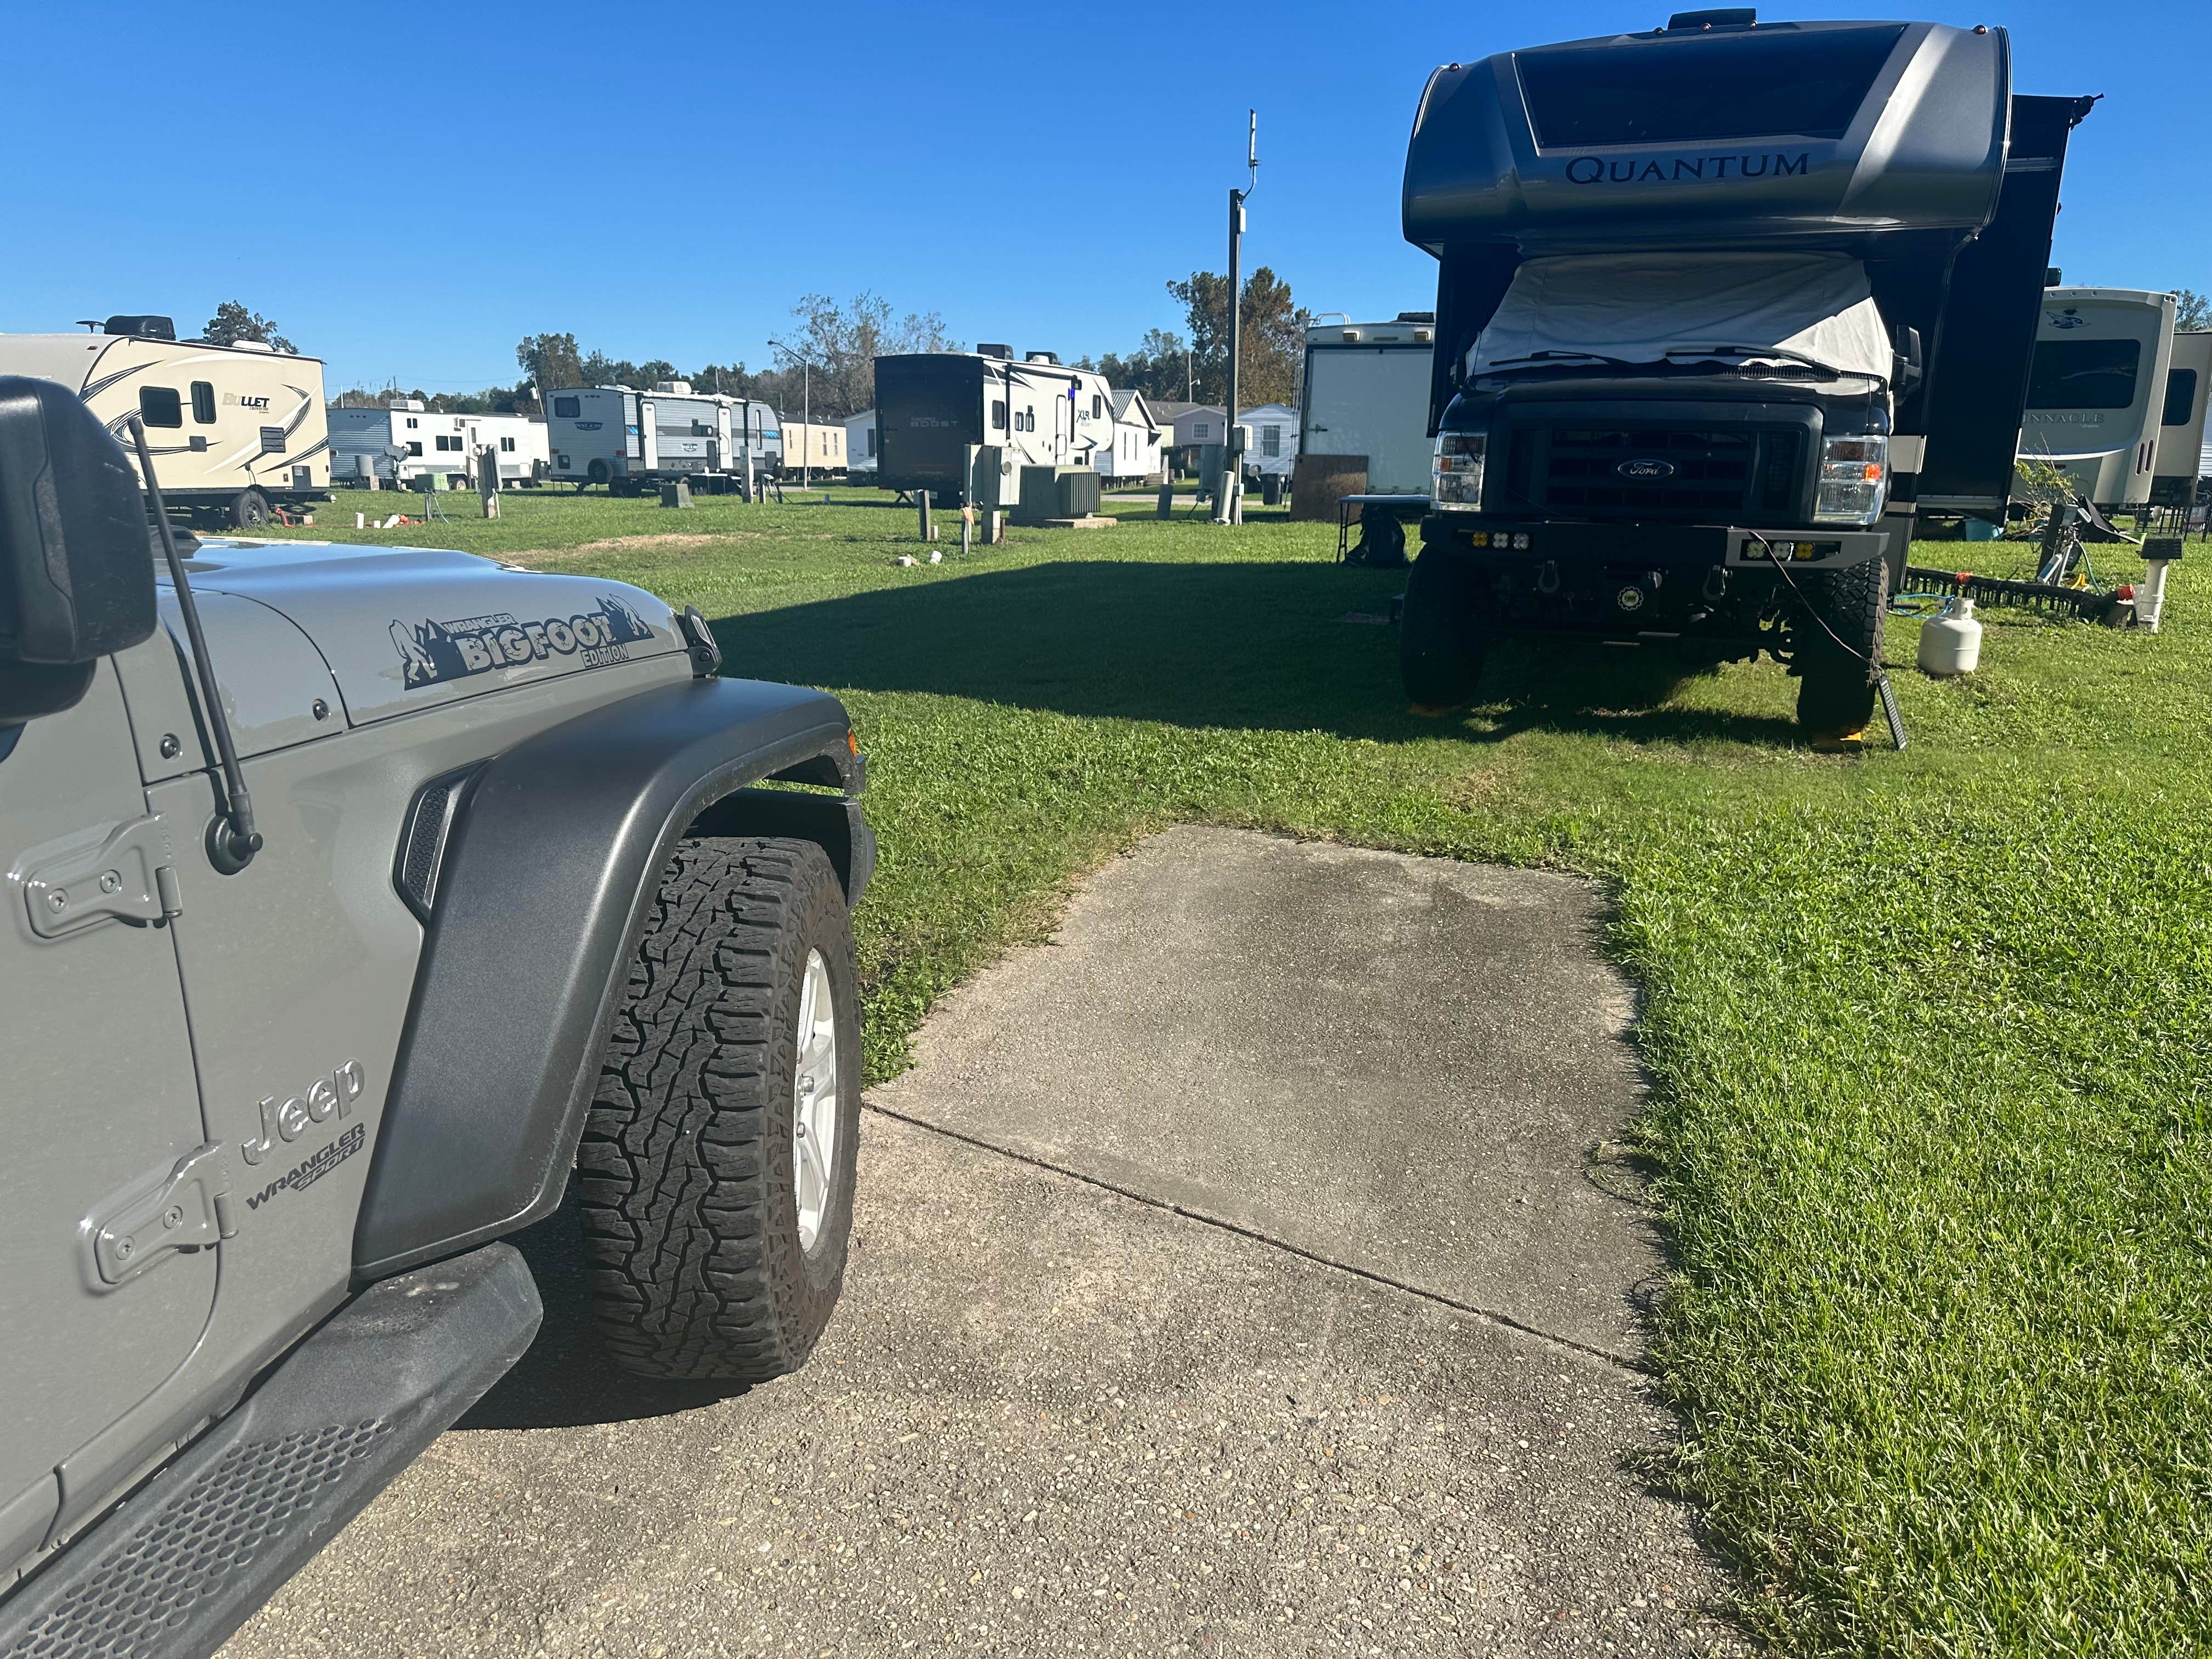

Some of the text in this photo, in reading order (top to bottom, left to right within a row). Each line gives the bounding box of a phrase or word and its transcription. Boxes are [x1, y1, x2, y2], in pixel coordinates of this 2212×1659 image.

[1565, 153, 1809, 184] QUANTUM
[222, 392, 270, 408] BULLET
[1076, 409, 1090, 422] XLR
[2022, 413, 2104, 424] INNACLE
[1629, 462, 1661, 475] Ford
[442, 613, 517, 634] WRANGLER
[453, 613, 618, 673] BIGFOOT
[580, 644, 630, 668] EDITION
[241, 1059, 365, 1165] Jeep
[246, 1122, 365, 1210] WRANGLER
[291, 1136, 365, 1192] SPORT
